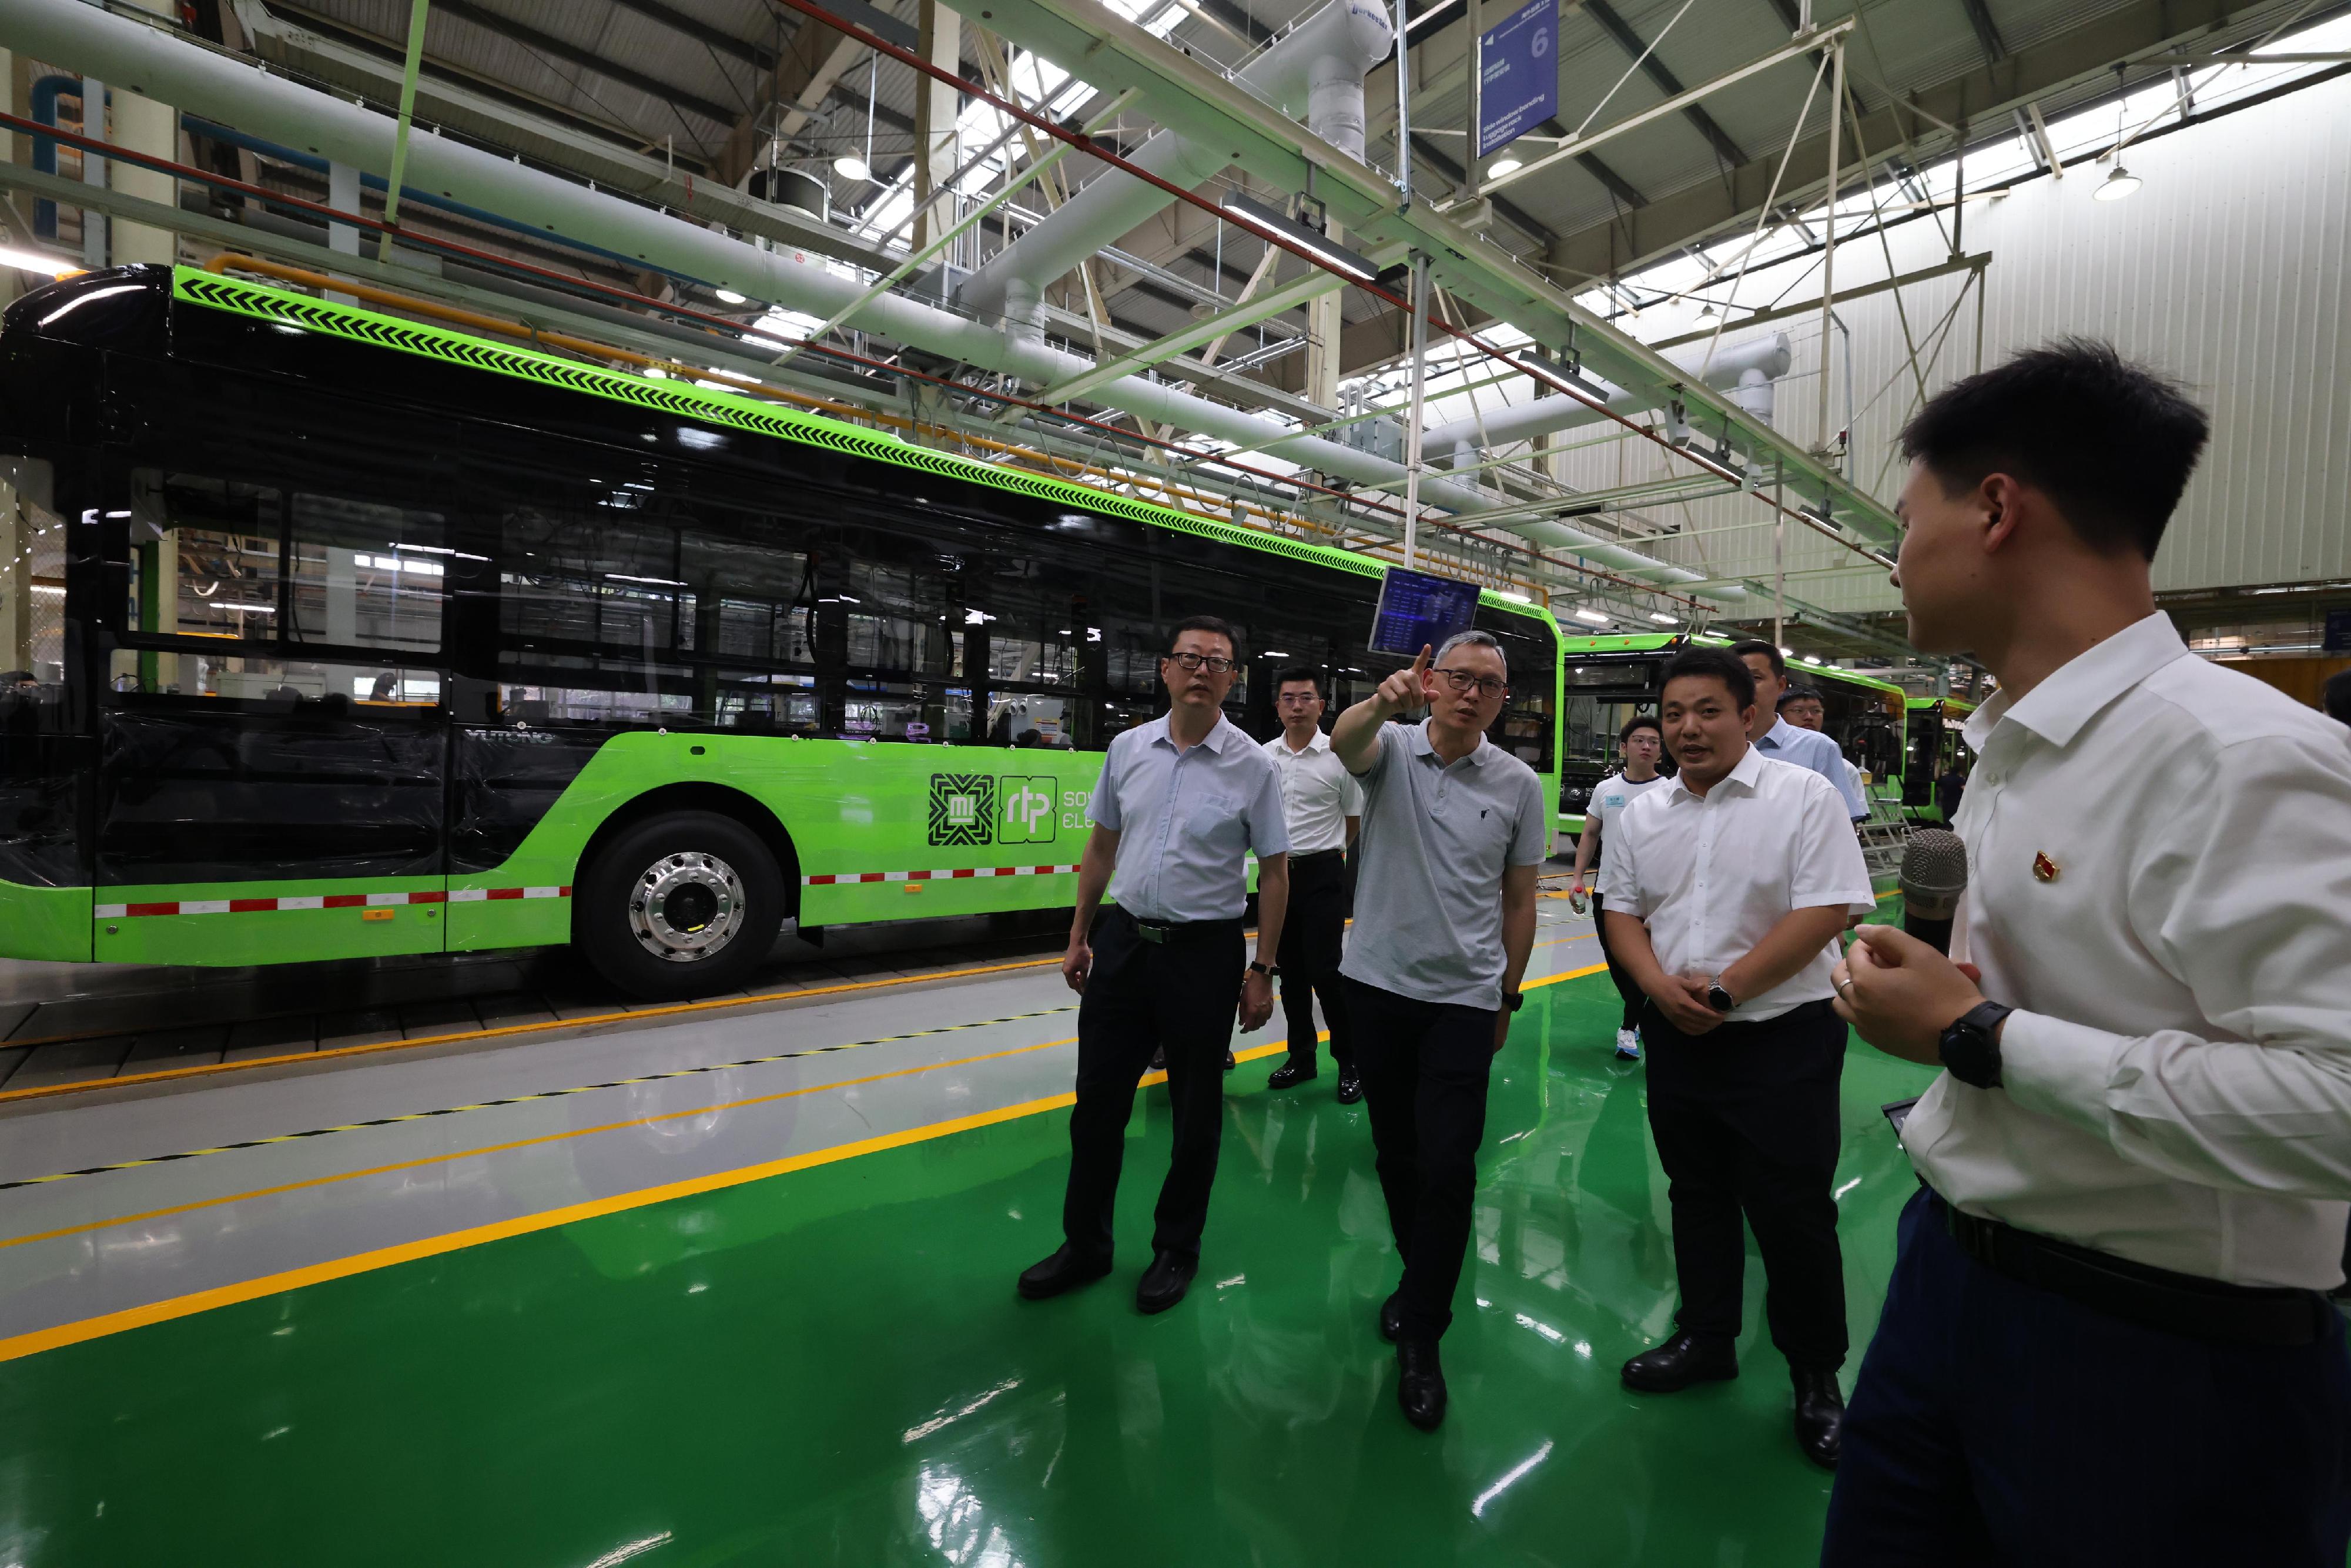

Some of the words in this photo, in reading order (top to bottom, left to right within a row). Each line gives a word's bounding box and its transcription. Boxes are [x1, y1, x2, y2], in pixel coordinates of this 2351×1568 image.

[1531, 27, 1549, 58] 6
[1483, 120, 1496, 133] Side
[1496, 108, 1519, 125] window
[1519, 93, 1545, 113] bonding
[1483, 122, 1508, 142] Luggage
[1508, 115, 1522, 129] rack
[464, 729, 554, 744] YUTONG
